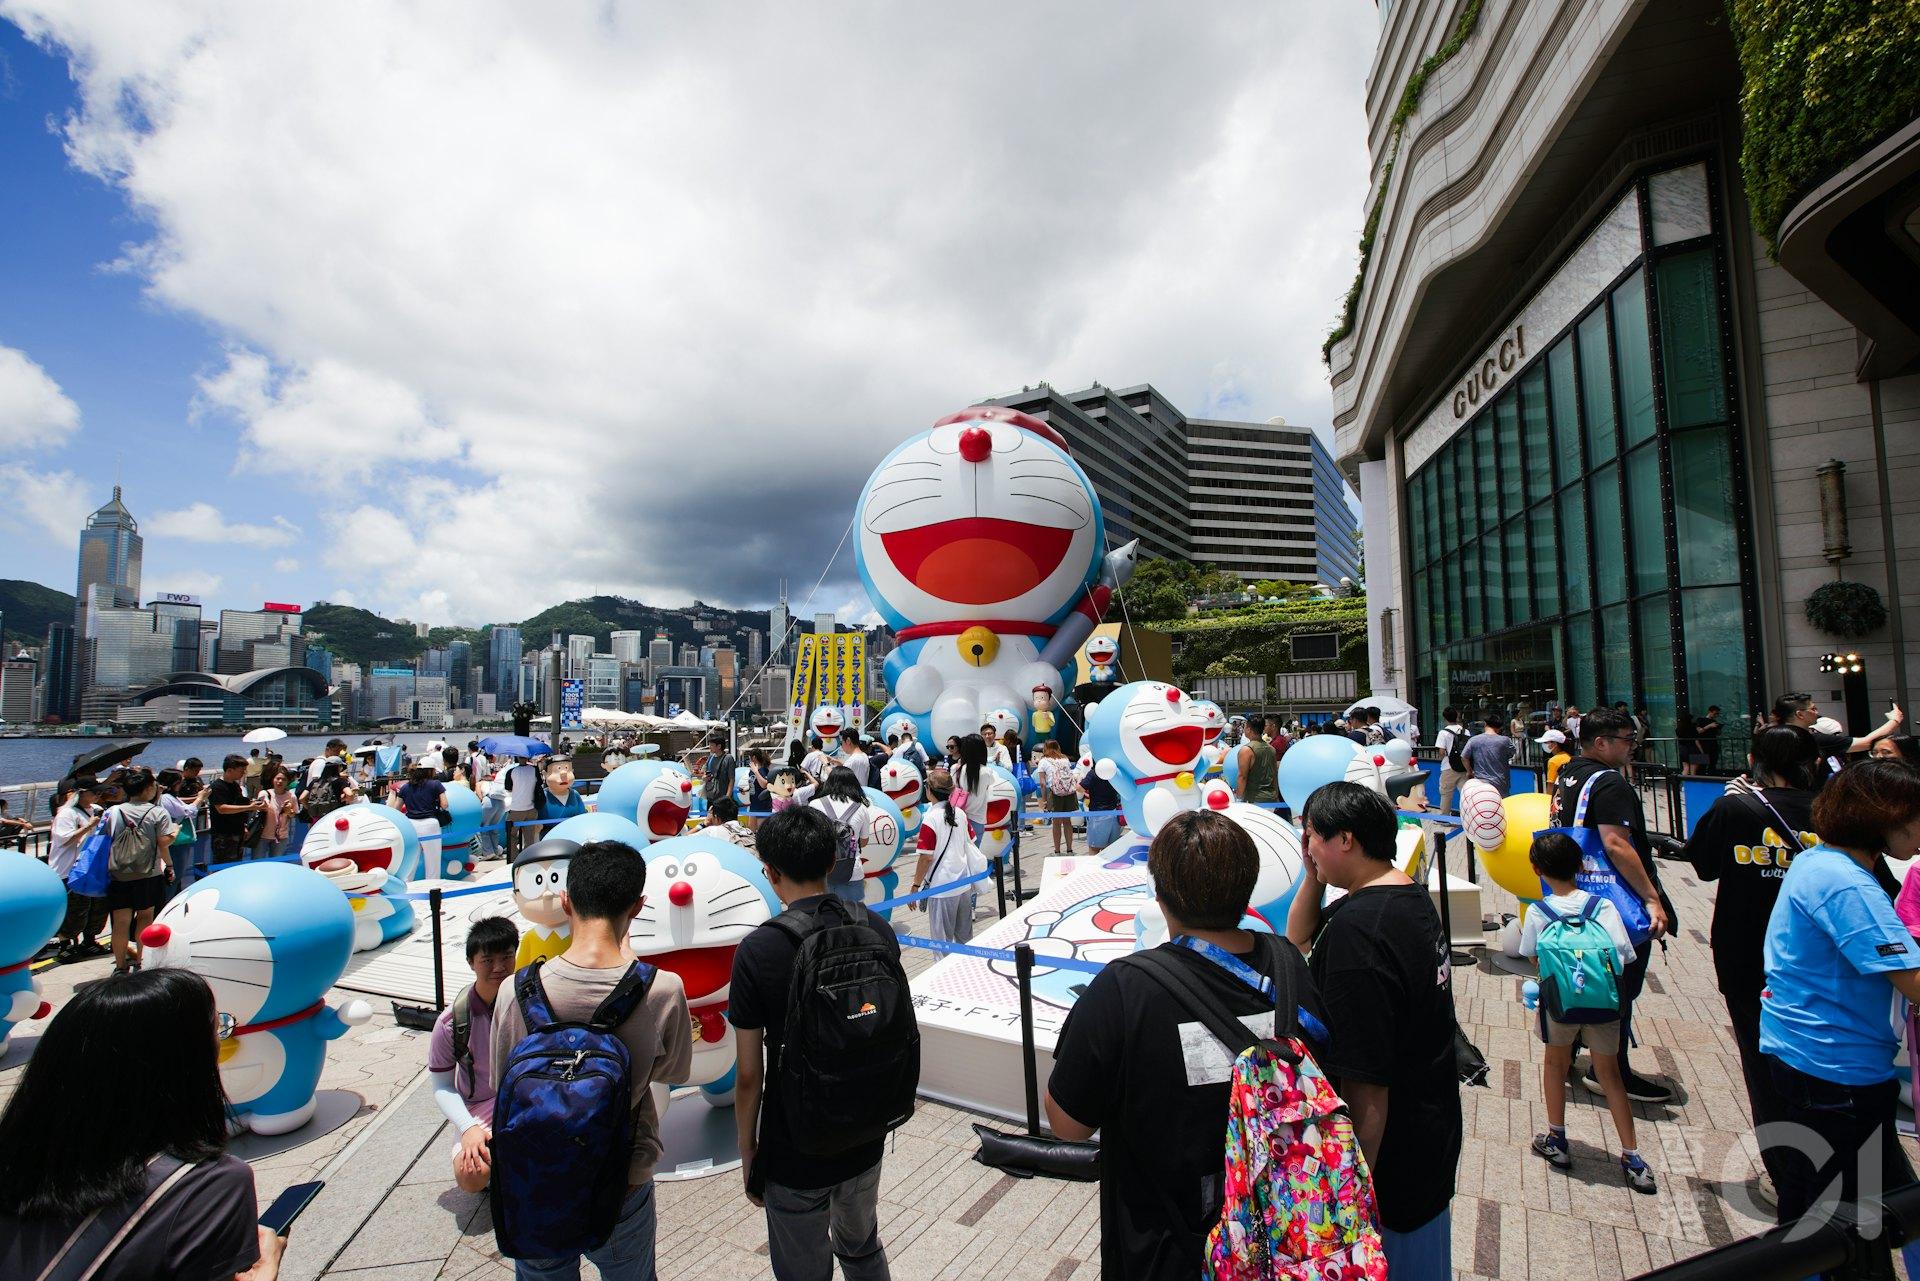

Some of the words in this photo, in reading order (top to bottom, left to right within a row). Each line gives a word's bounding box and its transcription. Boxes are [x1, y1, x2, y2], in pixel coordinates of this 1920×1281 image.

[1453, 325, 1525, 418] GUCCI
[167, 593, 190, 602] FWD
[1762, 827, 1824, 849] AM
[1734, 845, 1772, 866] DE
